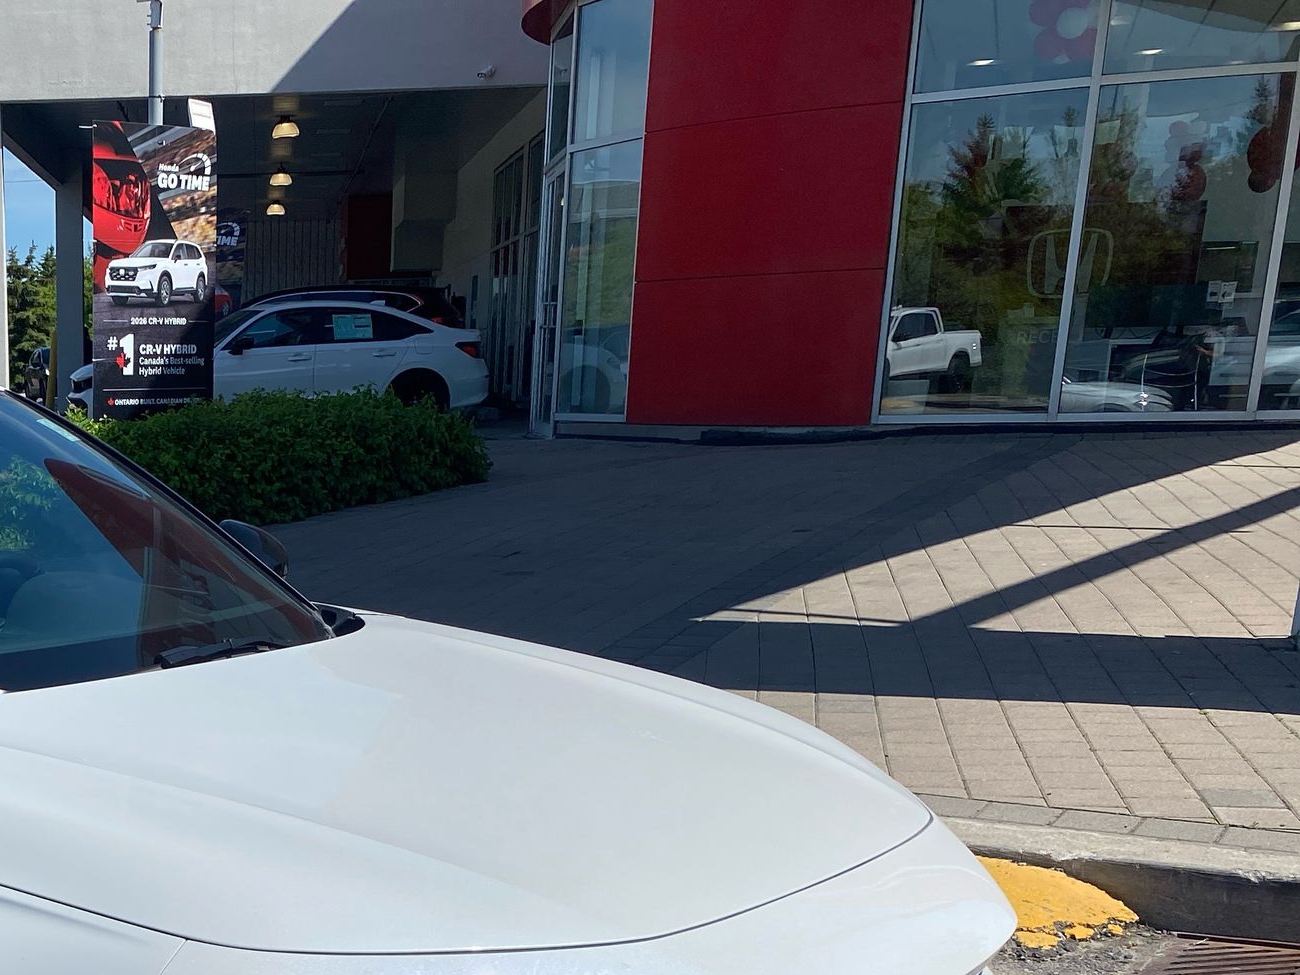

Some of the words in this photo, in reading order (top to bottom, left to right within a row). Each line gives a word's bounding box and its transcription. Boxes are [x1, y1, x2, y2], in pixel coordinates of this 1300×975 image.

[158, 163, 179, 172] Honda
[157, 173, 178, 189] GO
[179, 174, 211, 191] TIME
[216, 235, 238, 246] IME
[139, 344, 162, 355] CR-V
[163, 344, 197, 355] HYBRID
[138, 356, 169, 366] Canada's
[138, 367, 162, 378] Hybrid
